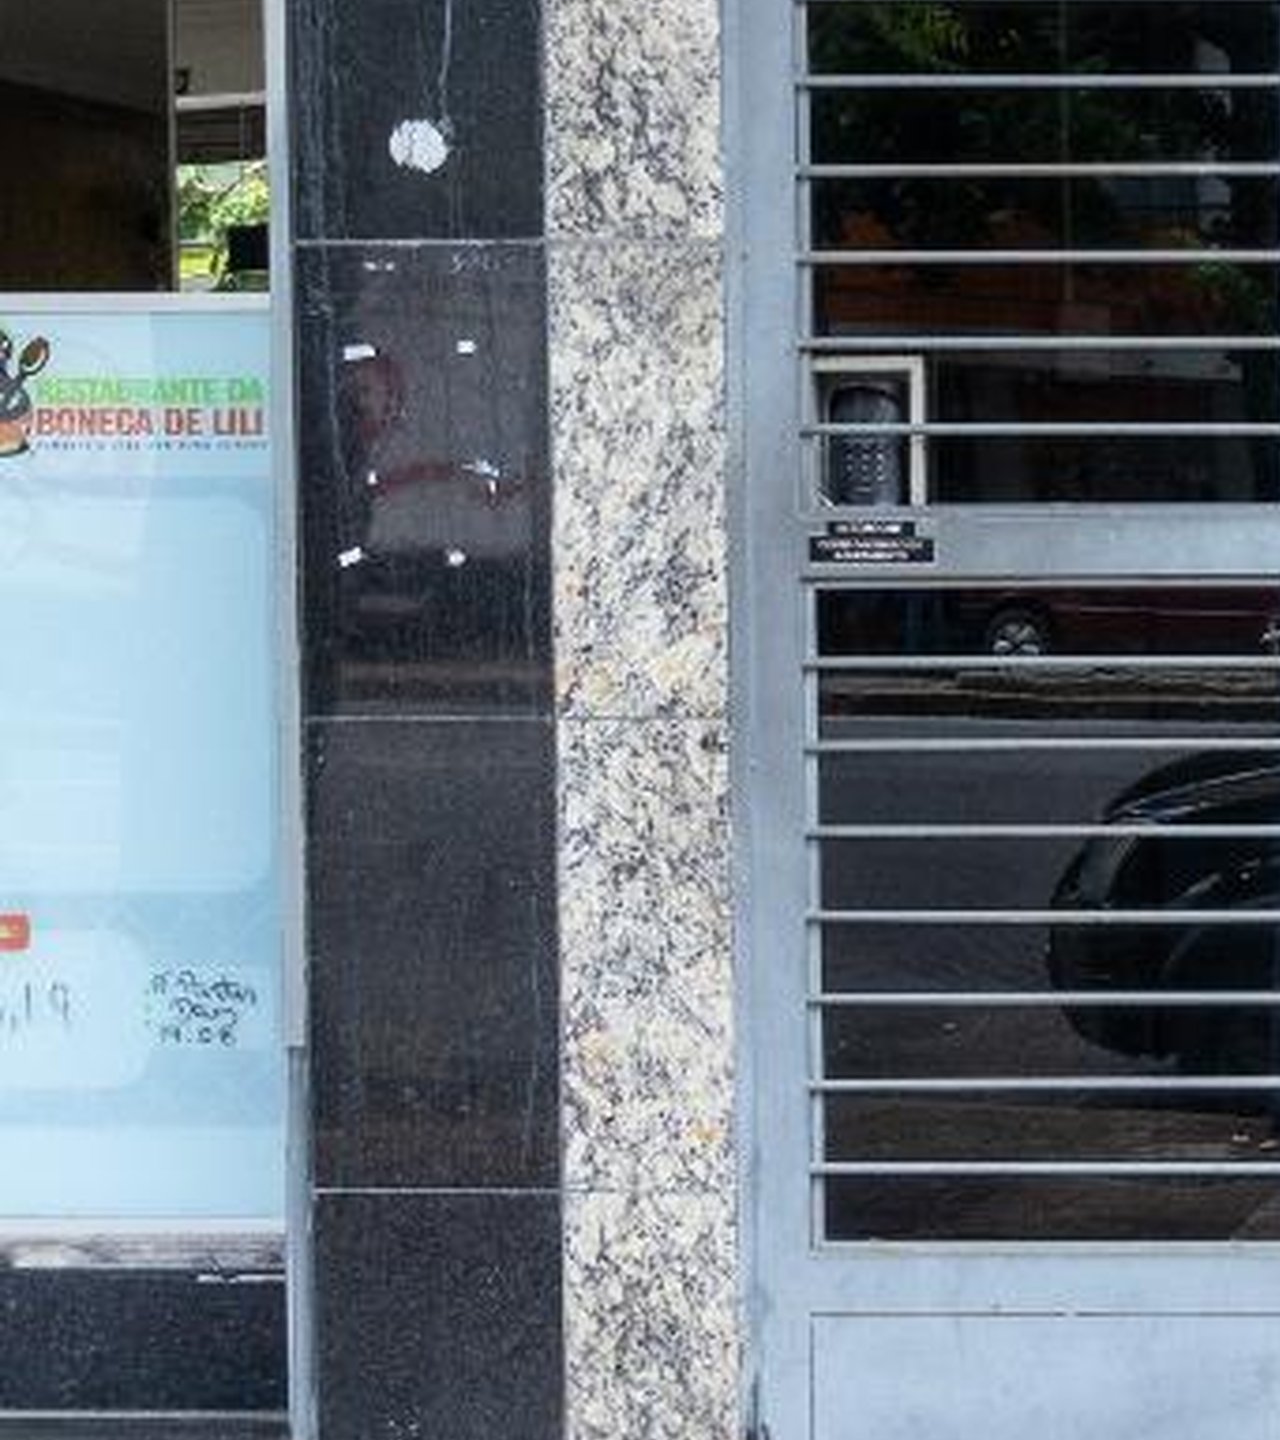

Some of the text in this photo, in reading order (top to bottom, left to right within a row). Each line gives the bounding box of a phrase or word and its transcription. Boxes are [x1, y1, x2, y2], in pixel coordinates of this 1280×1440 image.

[36, 407, 264, 437] BONECA DE LILI
